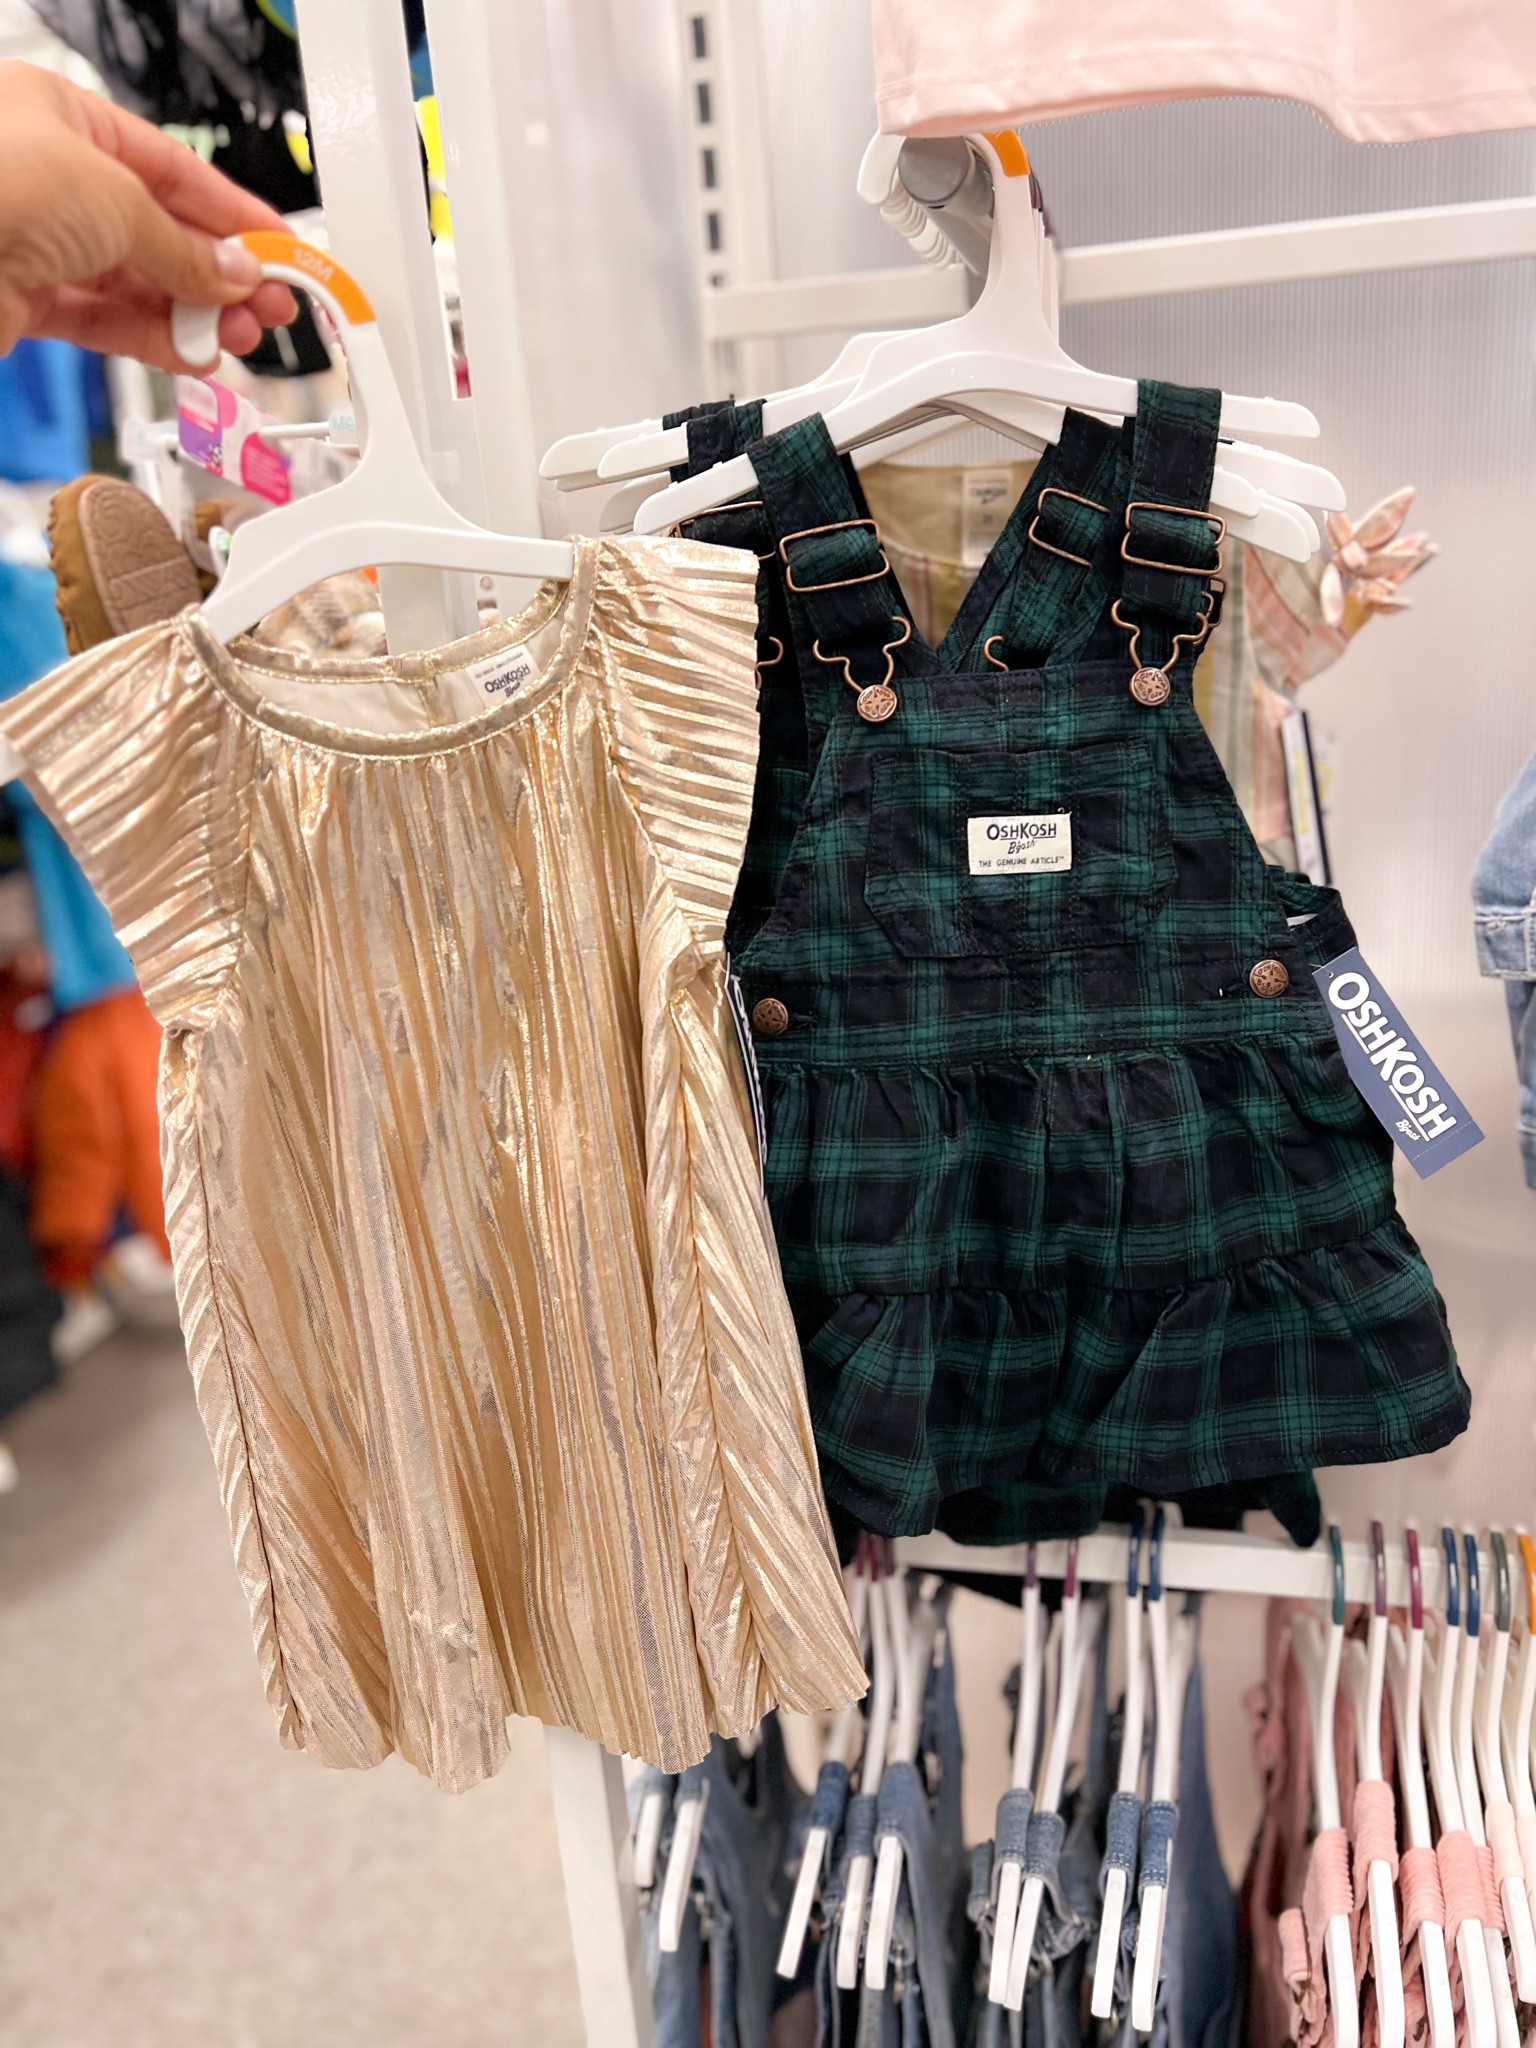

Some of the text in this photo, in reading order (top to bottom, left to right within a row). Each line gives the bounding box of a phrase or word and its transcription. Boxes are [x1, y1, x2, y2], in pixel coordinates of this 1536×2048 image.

[294, 246, 333, 280] 12M
[484, 663, 531, 693] OSHKOSH
[986, 822, 1057, 840] OSHKOSH
[978, 860, 992, 868] THE
[996, 858, 1027, 867] GENUINE
[1328, 972, 1457, 1142] OSHKOSH
